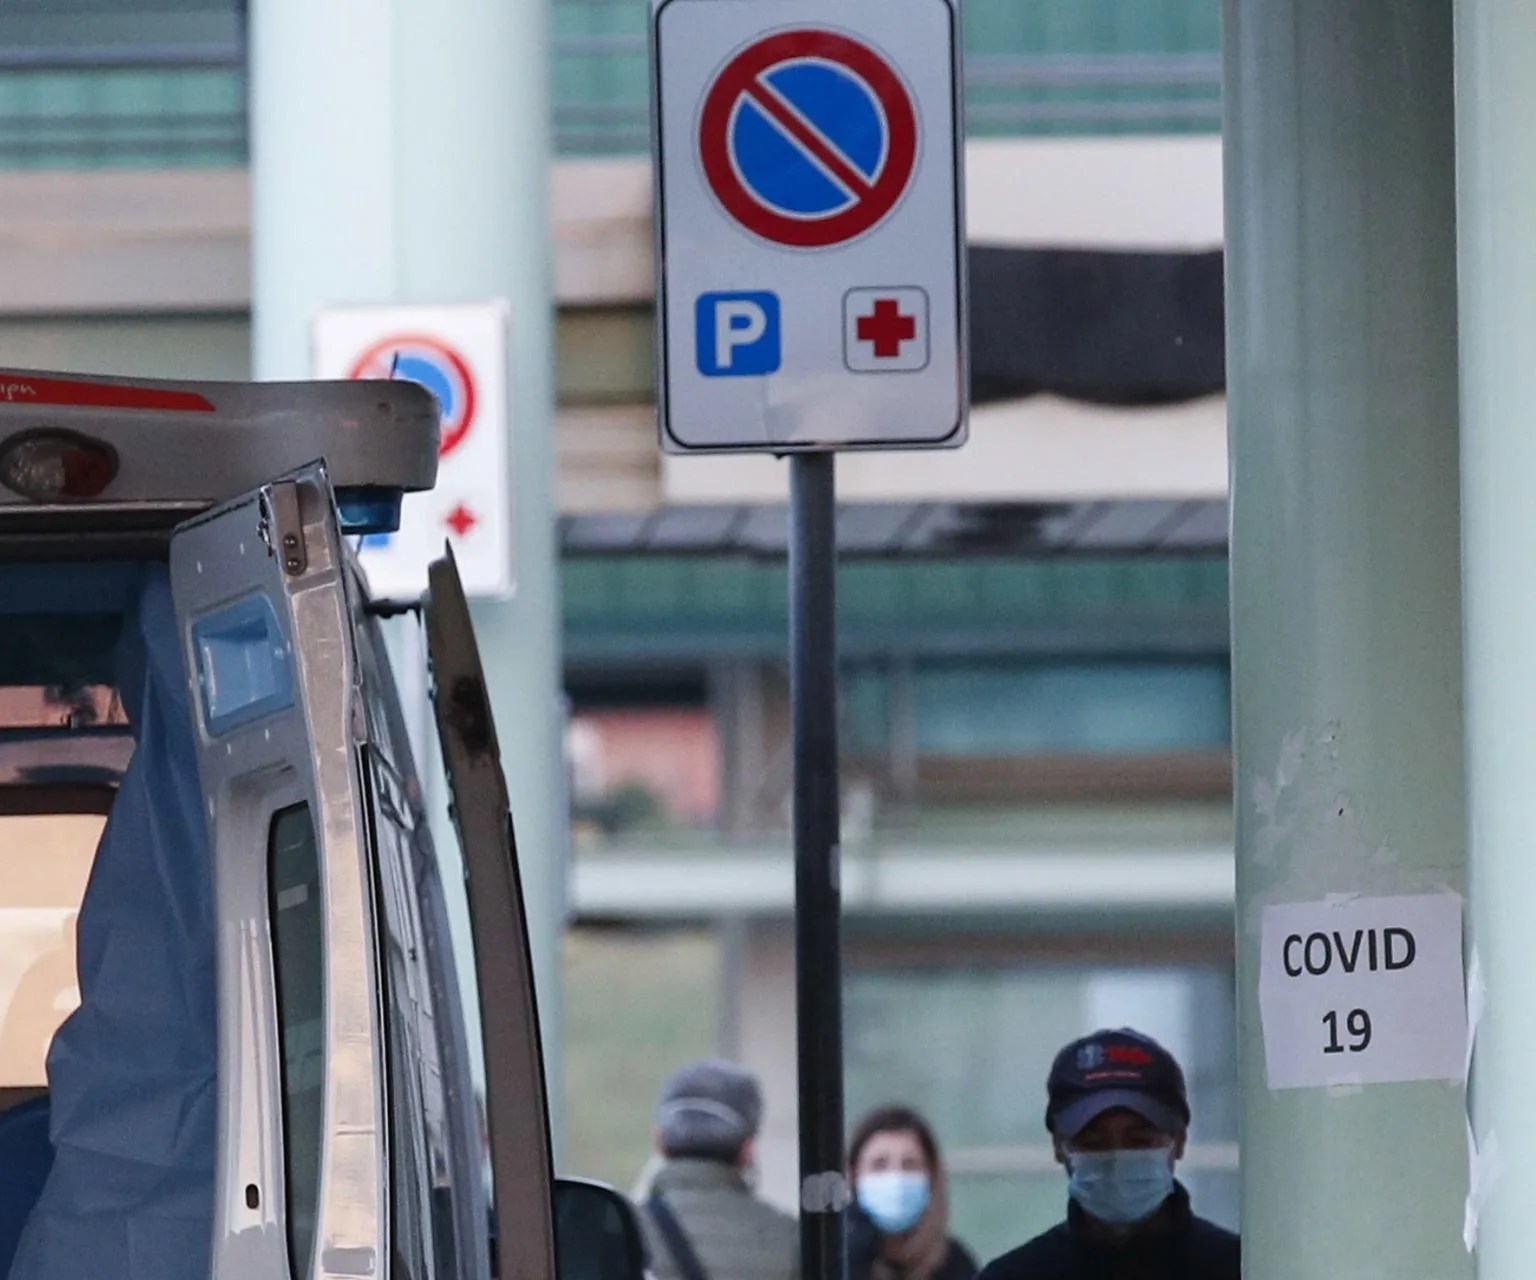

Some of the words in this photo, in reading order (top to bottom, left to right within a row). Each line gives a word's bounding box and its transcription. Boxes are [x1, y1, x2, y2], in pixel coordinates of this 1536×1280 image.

[715, 300, 768, 369] P
[1283, 927, 1417, 977] COVID
[1322, 1008, 1372, 1054] 19
